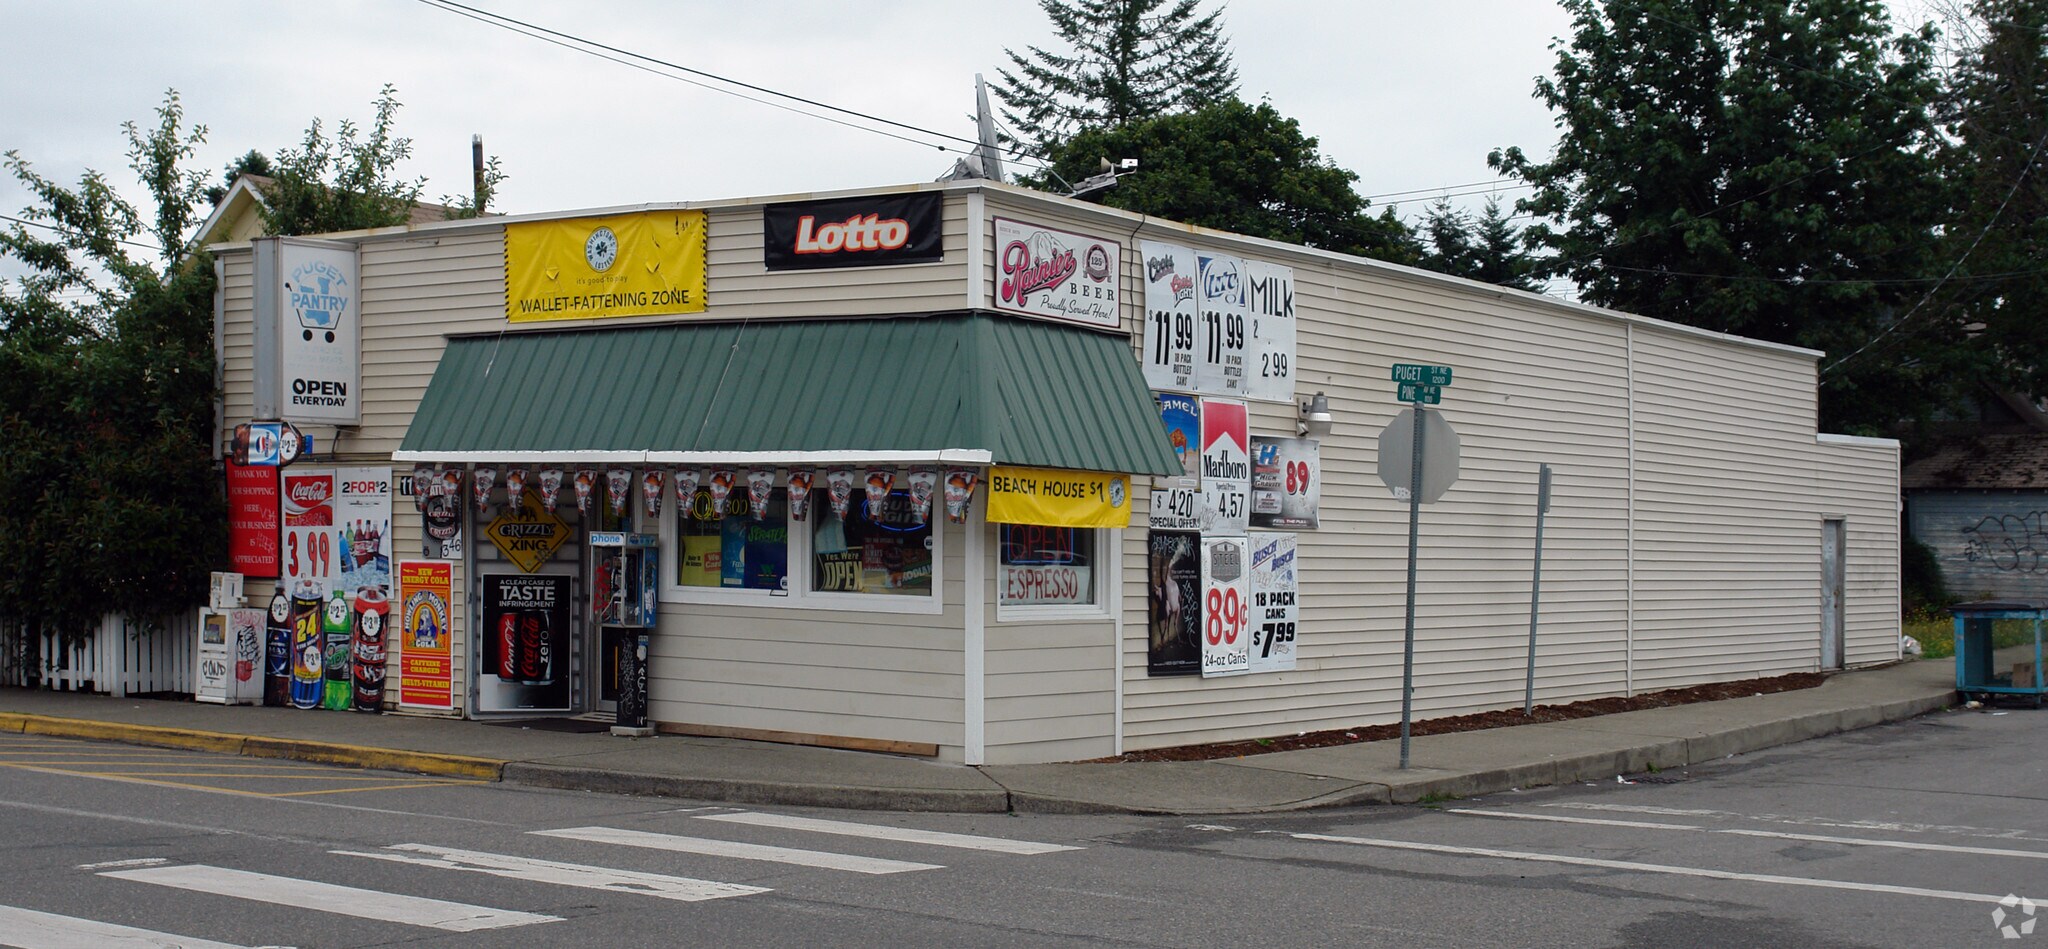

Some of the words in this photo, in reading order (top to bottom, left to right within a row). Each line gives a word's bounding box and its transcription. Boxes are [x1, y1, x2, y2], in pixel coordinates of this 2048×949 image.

[795, 213, 909, 253] Lotto
[291, 260, 348, 286] PUGET
[588, 276, 604, 286] good
[606, 275, 614, 283] to
[615, 274, 628, 283] play
[1001, 239, 1078, 308] Rainier
[1070, 282, 1115, 301] BEER
[1249, 273, 1294, 318] MILK
[291, 292, 348, 312] PANTRY
[520, 291, 647, 313] WALLET-FATTENING
[651, 288, 690, 306] ZONE
[1040, 294, 1067, 316] Proudly
[1068, 299, 1092, 316] Served
[1092, 303, 1114, 319] Here!
[1253, 319, 1259, 339] 2
[1181, 353, 1192, 364] PACK
[1173, 364, 1192, 376] BOTTLES
[1224, 366, 1242, 377] BOTTLES
[1395, 366, 1422, 381] PUGET
[1431, 367, 1438, 375] ST
[292, 378, 347, 397] OPEN
[292, 395, 347, 407] EVERYDAY
[1162, 400, 1198, 417] AMEL
[1203, 449, 1247, 480] Marlboro
[234, 469, 255, 478] THANK
[255, 469, 270, 478] YOU
[242, 487, 275, 496] SHOPPING
[993, 476, 1037, 495] BEACH
[1043, 480, 1085, 499] HOUSE
[244, 504, 260, 513] HERE
[247, 521, 276, 530] BUSINESS
[1149, 516, 1177, 528] SPECIAL
[499, 522, 556, 538] GRIZZLY
[249, 538, 256, 547] IS
[510, 539, 548, 551] XING
[591, 533, 620, 544] phone
[1010, 526, 1071, 560] OPEN
[235, 555, 274, 564] APPRECIATED
[1213, 552, 1239, 566] STEEL
[1252, 539, 1278, 567] BUSCH
[1271, 548, 1295, 572] BUSCH
[402, 575, 429, 584] ENERGY
[430, 576, 449, 585] COLA
[417, 568, 433, 577] NEW
[824, 561, 863, 590] OPEN
[1007, 568, 1078, 600] ESPRESSO
[499, 585, 556, 601] TASTE
[1255, 592, 1267, 606] 18
[1270, 591, 1295, 607] PACK
[404, 592, 423, 630] HOWLING
[427, 592, 448, 631] MONKEY
[498, 600, 556, 608] INFRINGEMENT
[1265, 607, 1286, 620] CANS
[415, 639, 436, 648] COLA
[540, 630, 549, 664] zero
[1204, 653, 1226, 667] 24-oz
[1228, 652, 1247, 665] Cans
[402, 678, 450, 688] MULTI-VITAMIN
